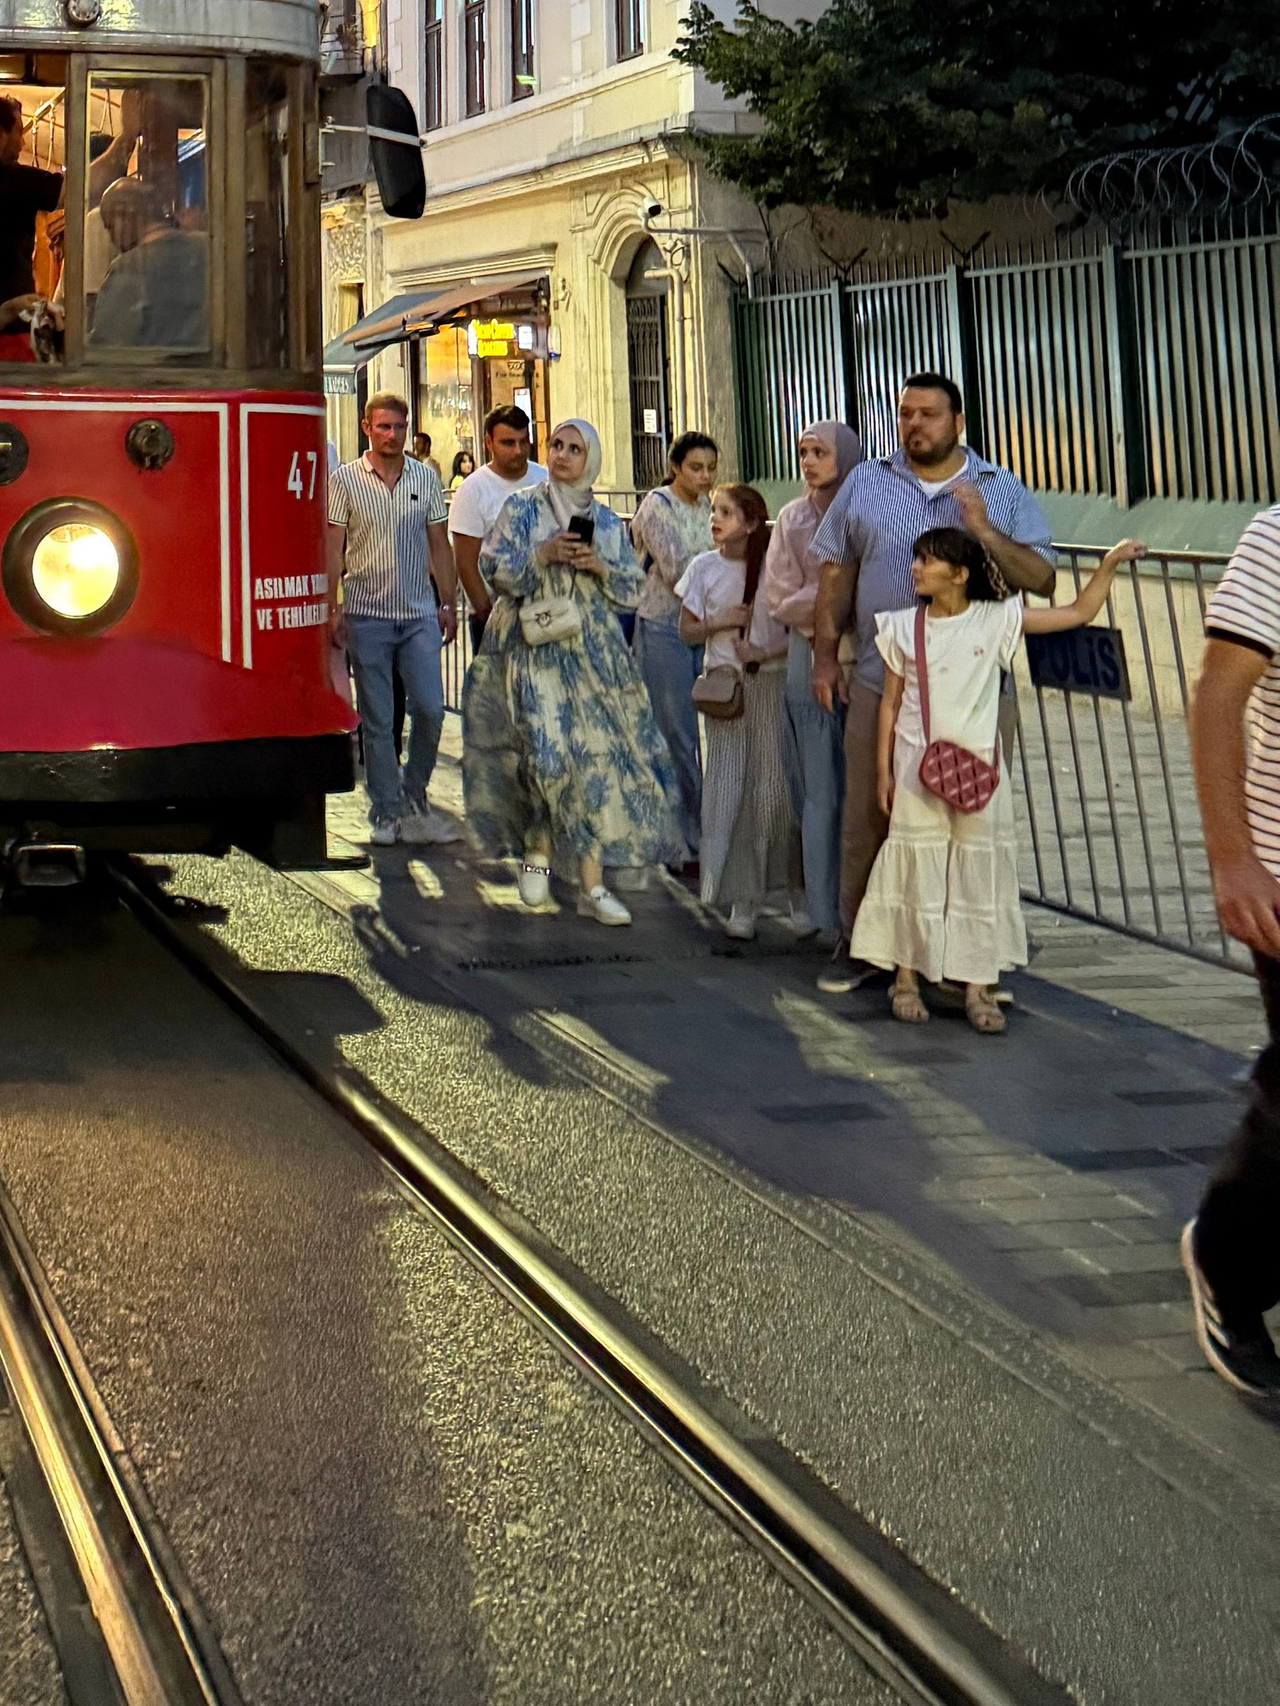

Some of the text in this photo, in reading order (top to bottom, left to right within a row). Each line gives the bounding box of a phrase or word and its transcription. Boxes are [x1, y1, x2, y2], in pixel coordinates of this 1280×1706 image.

[287, 451, 317, 500] 47
[254, 575, 310, 600] ASILMAK
[256, 608, 273, 631] VE
